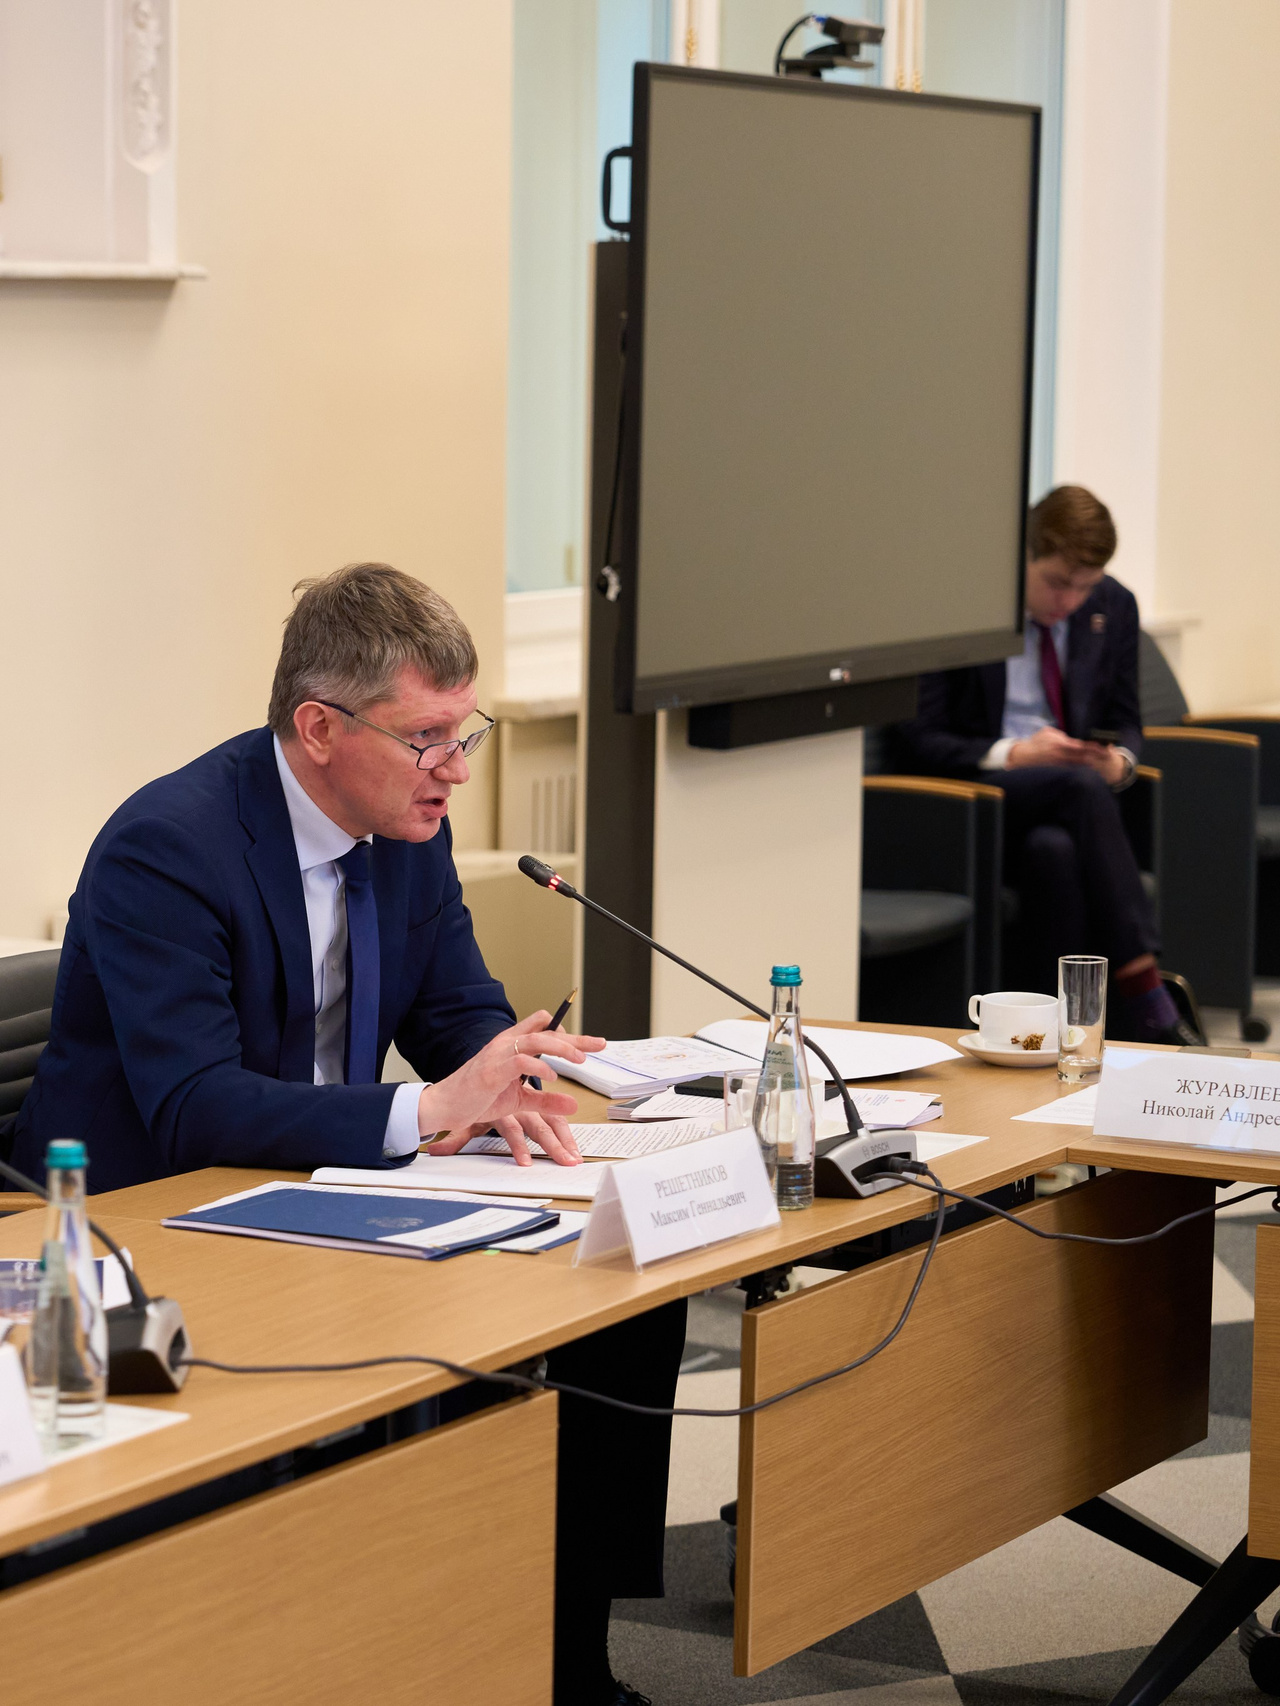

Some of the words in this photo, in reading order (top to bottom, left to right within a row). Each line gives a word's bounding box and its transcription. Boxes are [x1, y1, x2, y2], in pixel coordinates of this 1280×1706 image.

[1142, 1099, 1214, 1120] Николай
[870, 1142, 890, 1155] BOSCH
[654, 1164, 728, 1198] РЕШЕТНИКОВ
[650, 1209, 690, 1228] Максим
[689, 1191, 747, 1217] Геннадьевич
